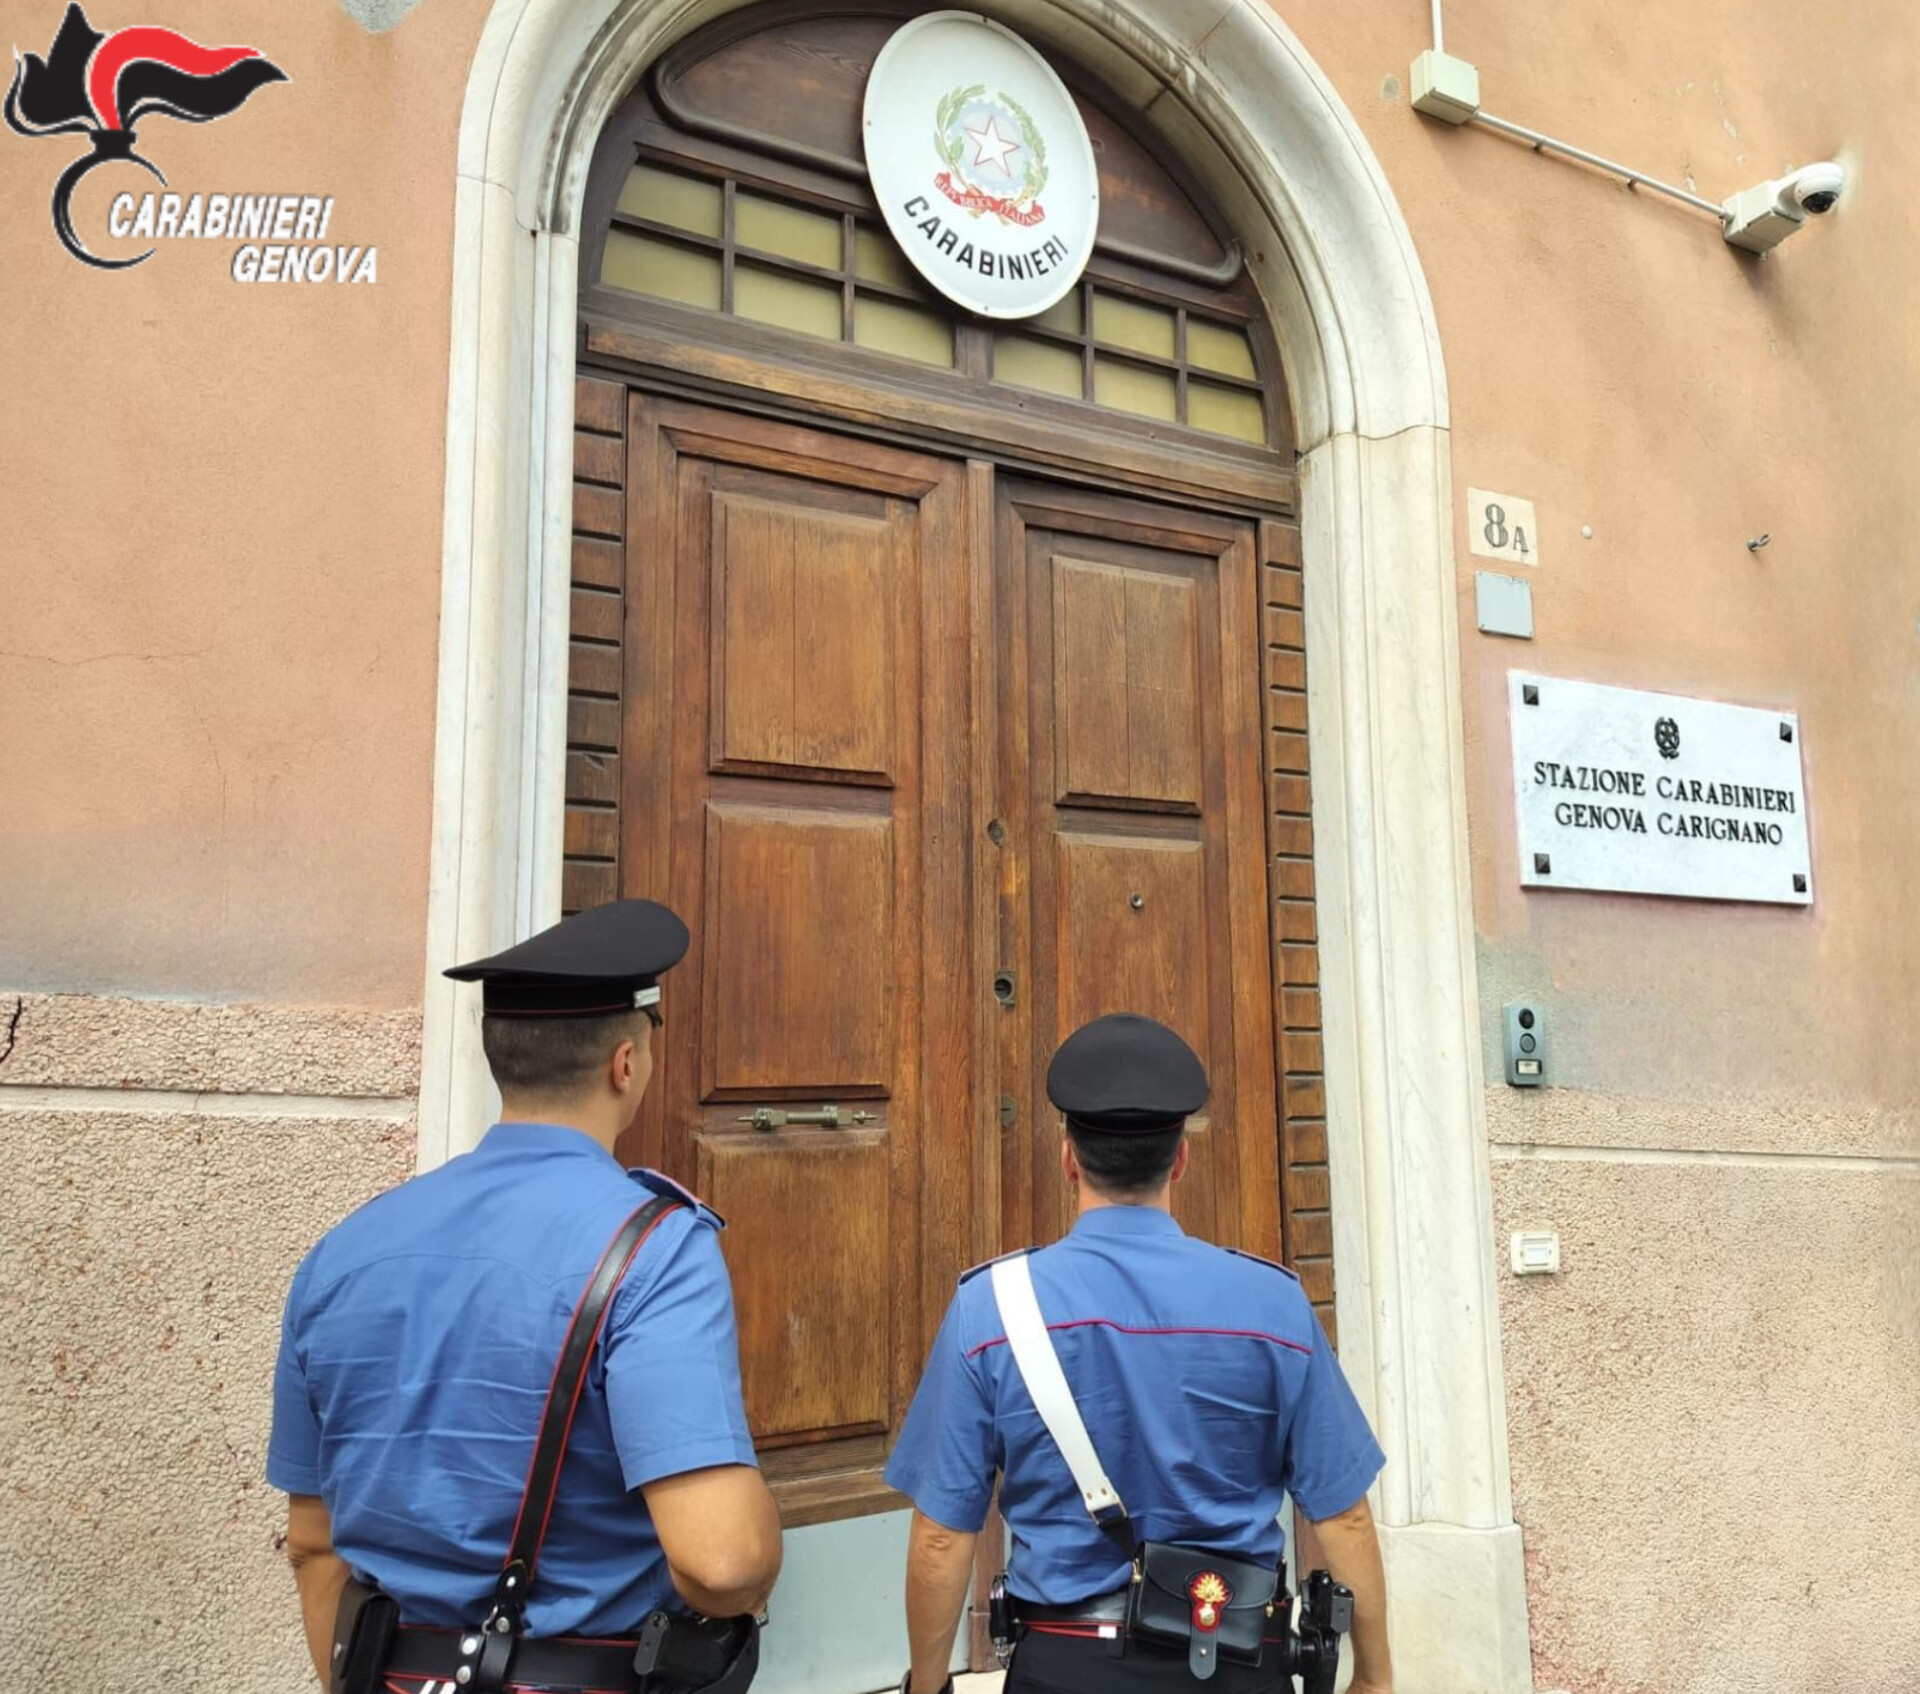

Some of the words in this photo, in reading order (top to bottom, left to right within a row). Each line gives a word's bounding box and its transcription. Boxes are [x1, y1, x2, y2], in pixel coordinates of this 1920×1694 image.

[903, 195, 1069, 281] CARABINIERI
[1534, 761, 1646, 797] STAZIONE
[1656, 775, 1796, 814] CARABINIERI
[1554, 802, 1648, 834] GENOVA
[1656, 811, 1784, 846] CARIGNANO
